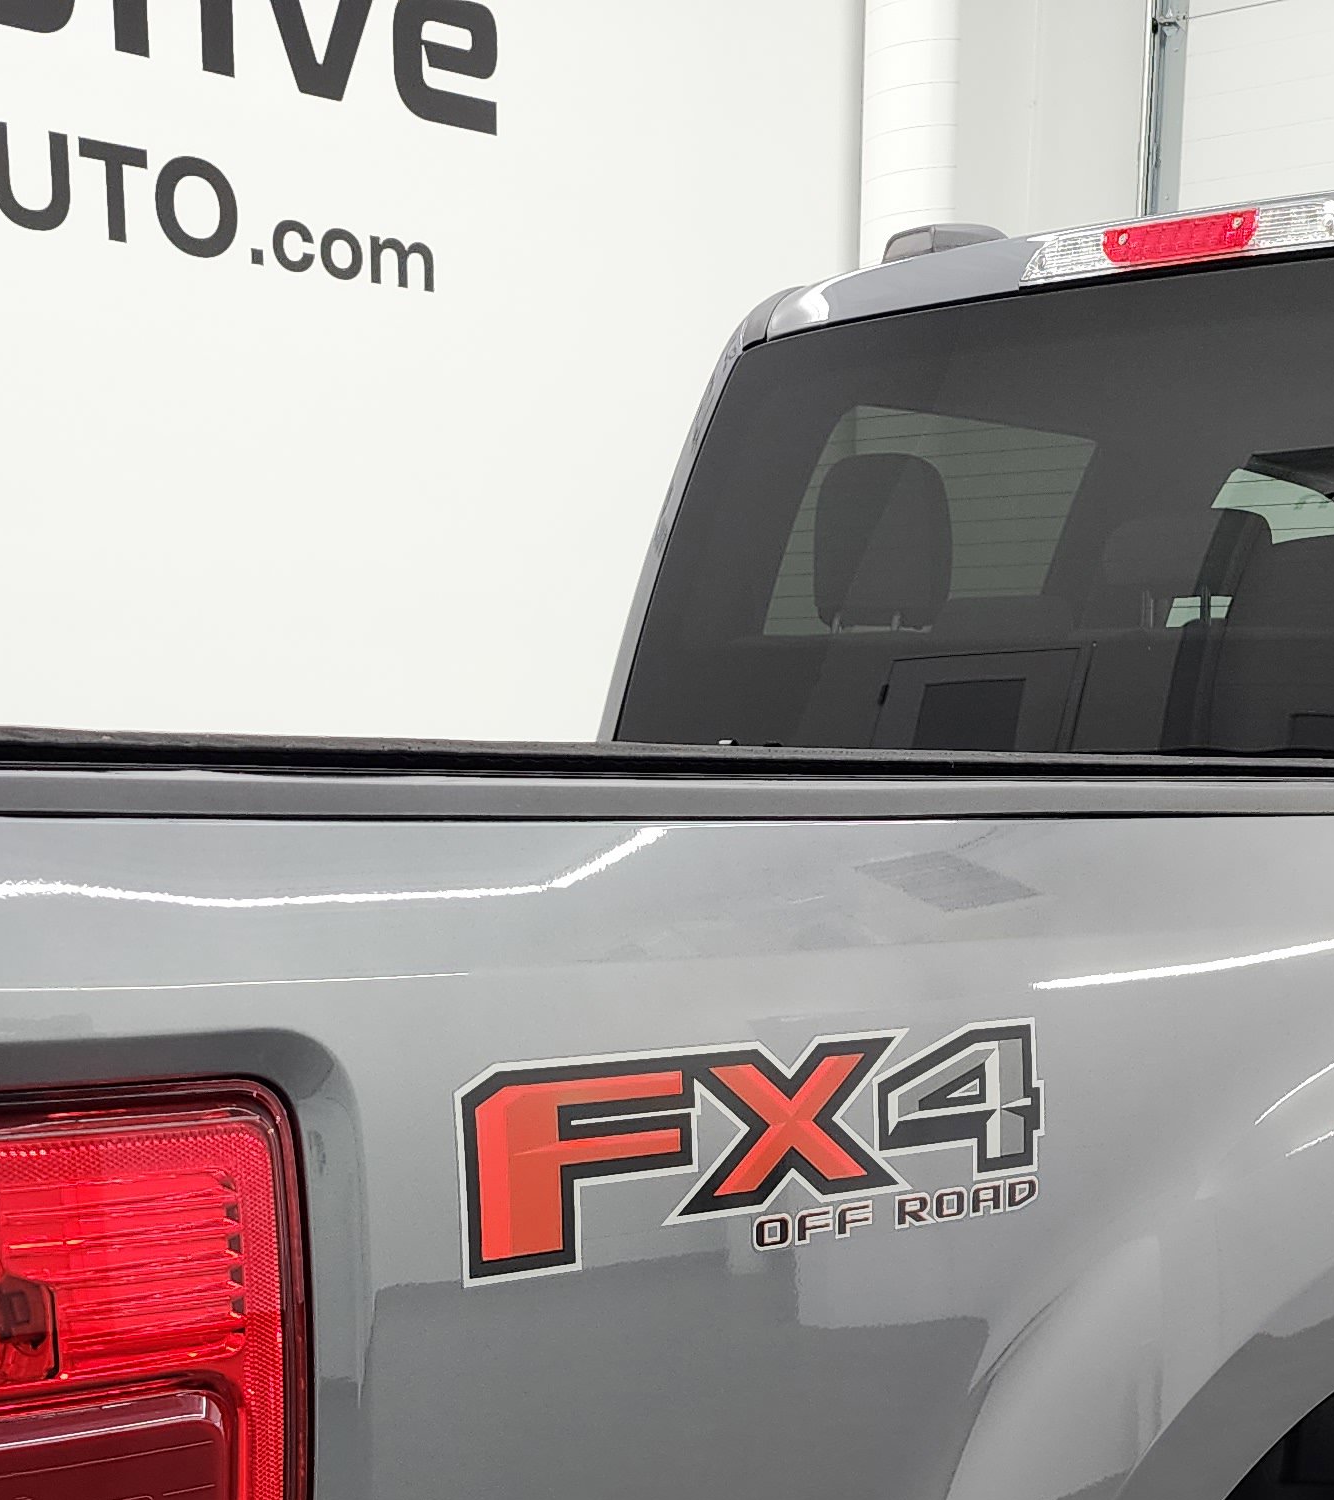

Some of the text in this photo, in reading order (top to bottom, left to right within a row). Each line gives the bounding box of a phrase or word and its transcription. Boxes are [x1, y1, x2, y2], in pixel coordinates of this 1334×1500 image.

[454, 1017, 1045, 1288] FX4
[753, 1175, 1041, 1252] OFF ROAD
